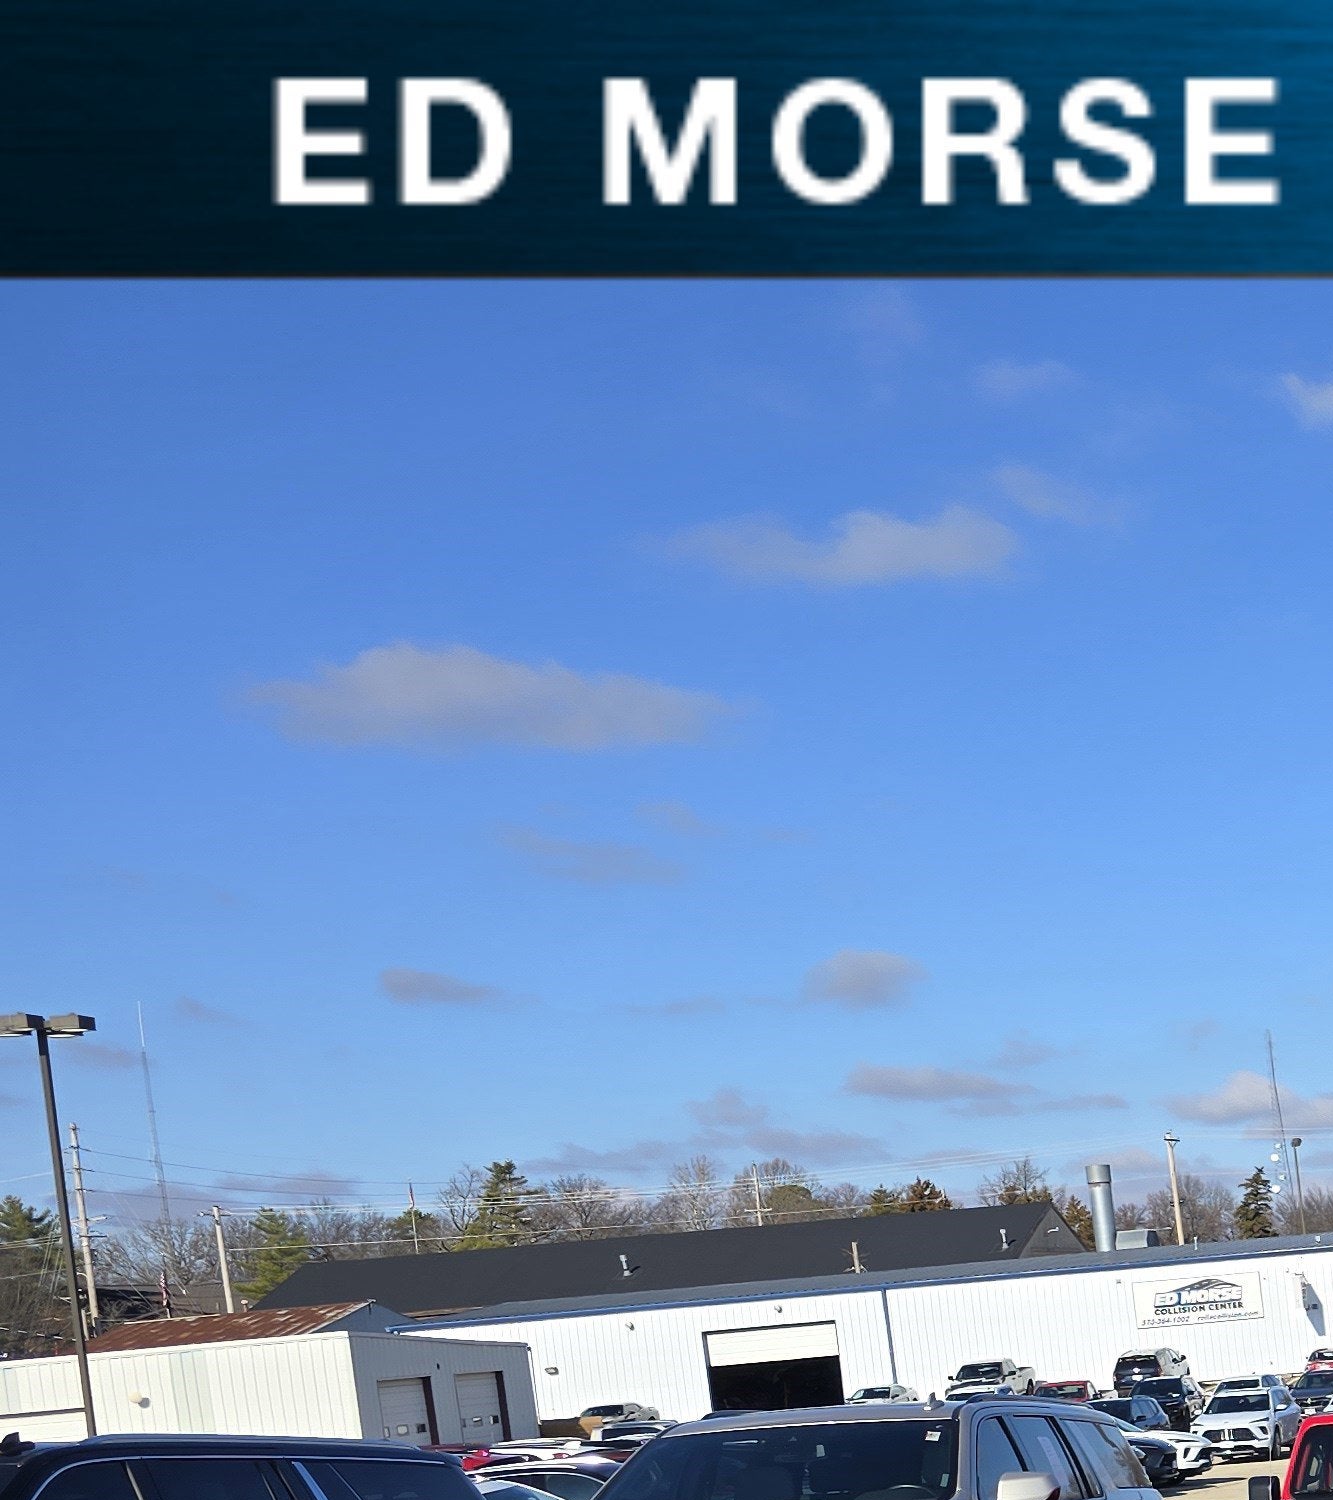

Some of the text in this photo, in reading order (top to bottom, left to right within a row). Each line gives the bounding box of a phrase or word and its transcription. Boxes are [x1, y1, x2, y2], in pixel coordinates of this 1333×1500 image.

[1154, 1286, 1242, 1307] ED MORSE
[1154, 1301, 1244, 1315] COLLISION CENTER
